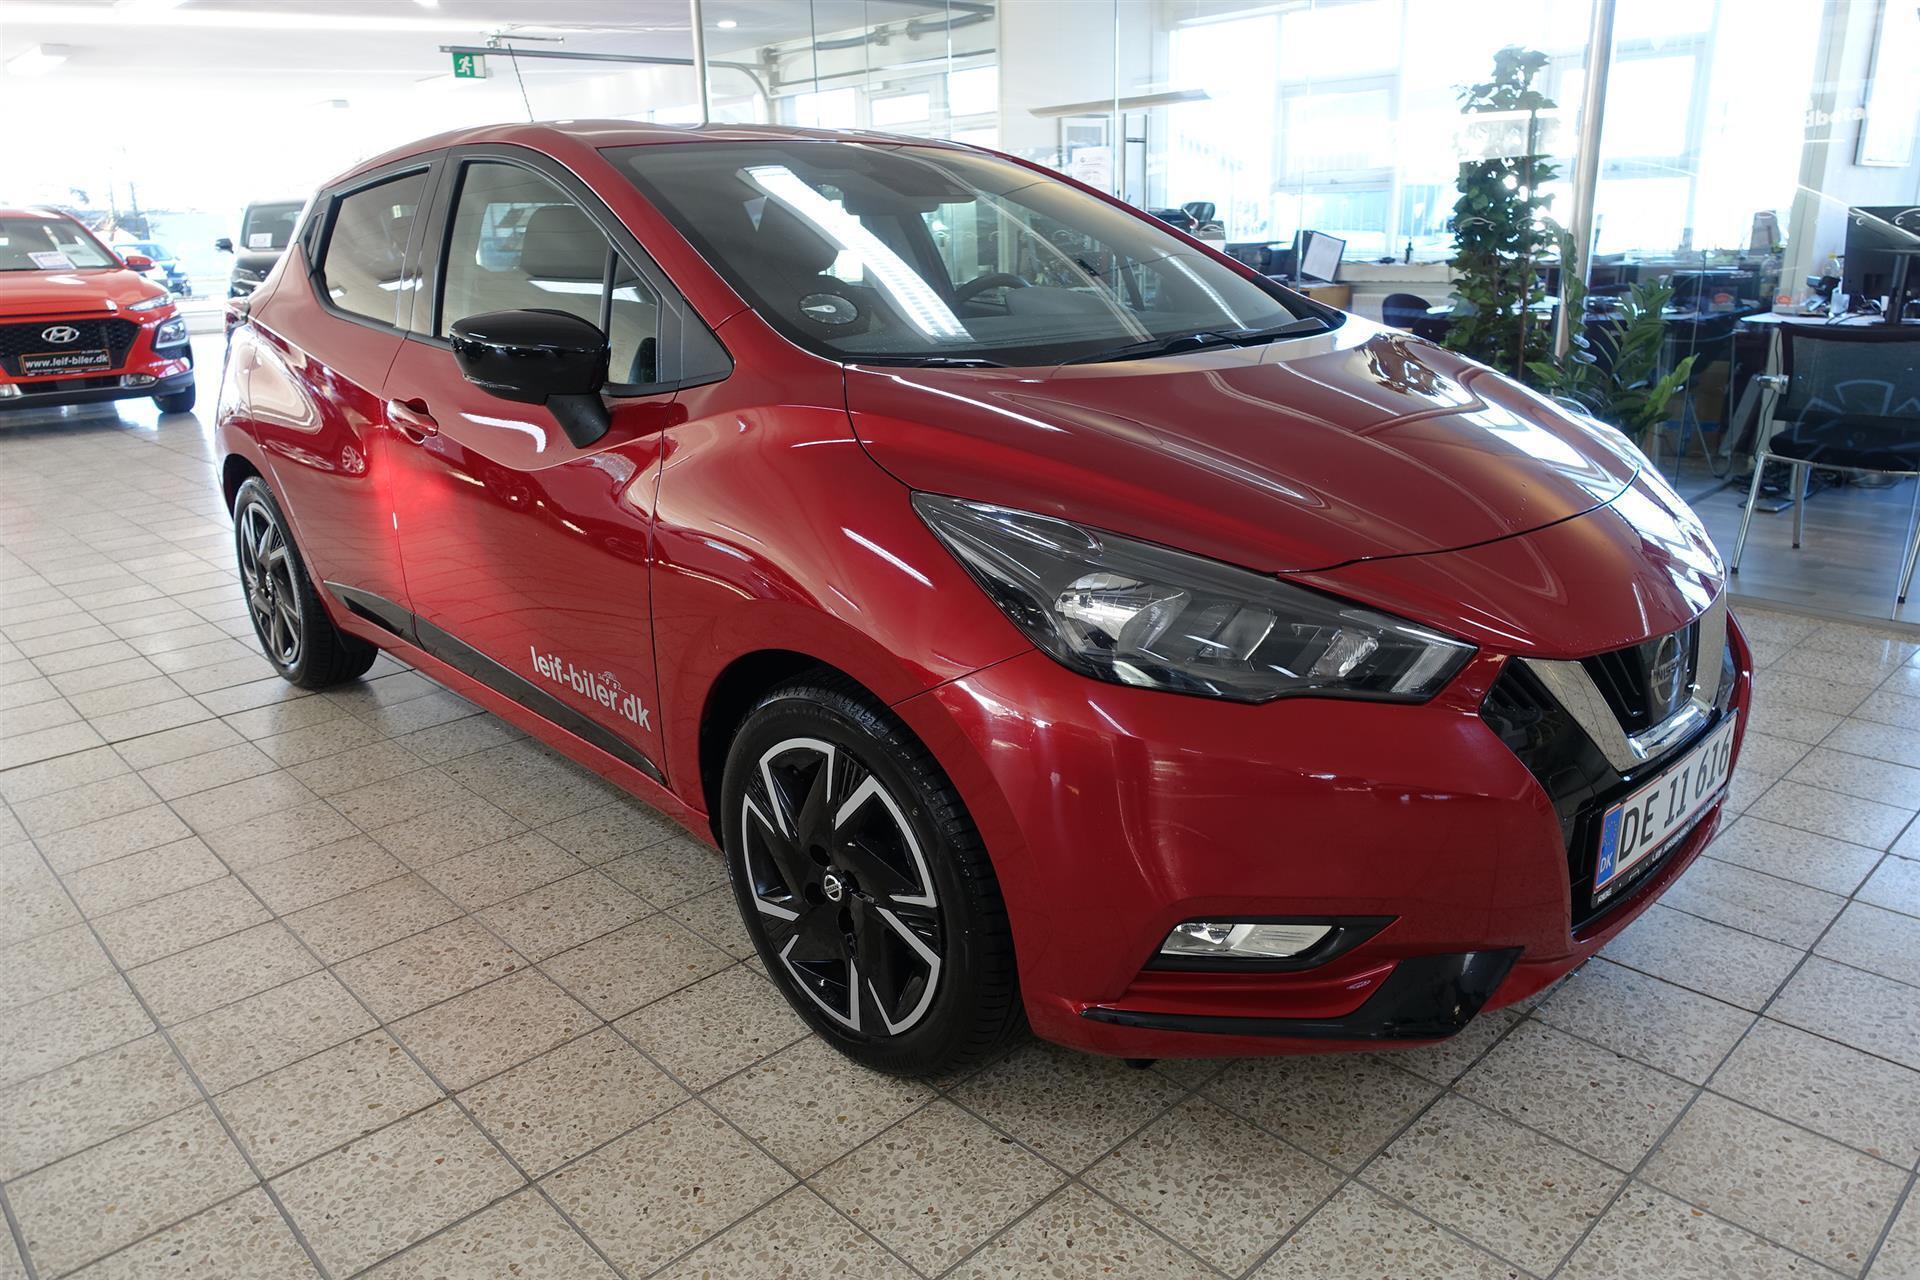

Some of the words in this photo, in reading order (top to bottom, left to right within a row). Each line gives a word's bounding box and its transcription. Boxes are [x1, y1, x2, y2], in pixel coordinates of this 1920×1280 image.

[25, 354, 108, 368] www.leif-biler.dk
[530, 645, 652, 732] leif-biler.dk
[1618, 790, 1660, 863] DE
[1664, 766, 1691, 829] 11
[1695, 727, 1731, 799] 616
[1599, 852, 1613, 873] DK
